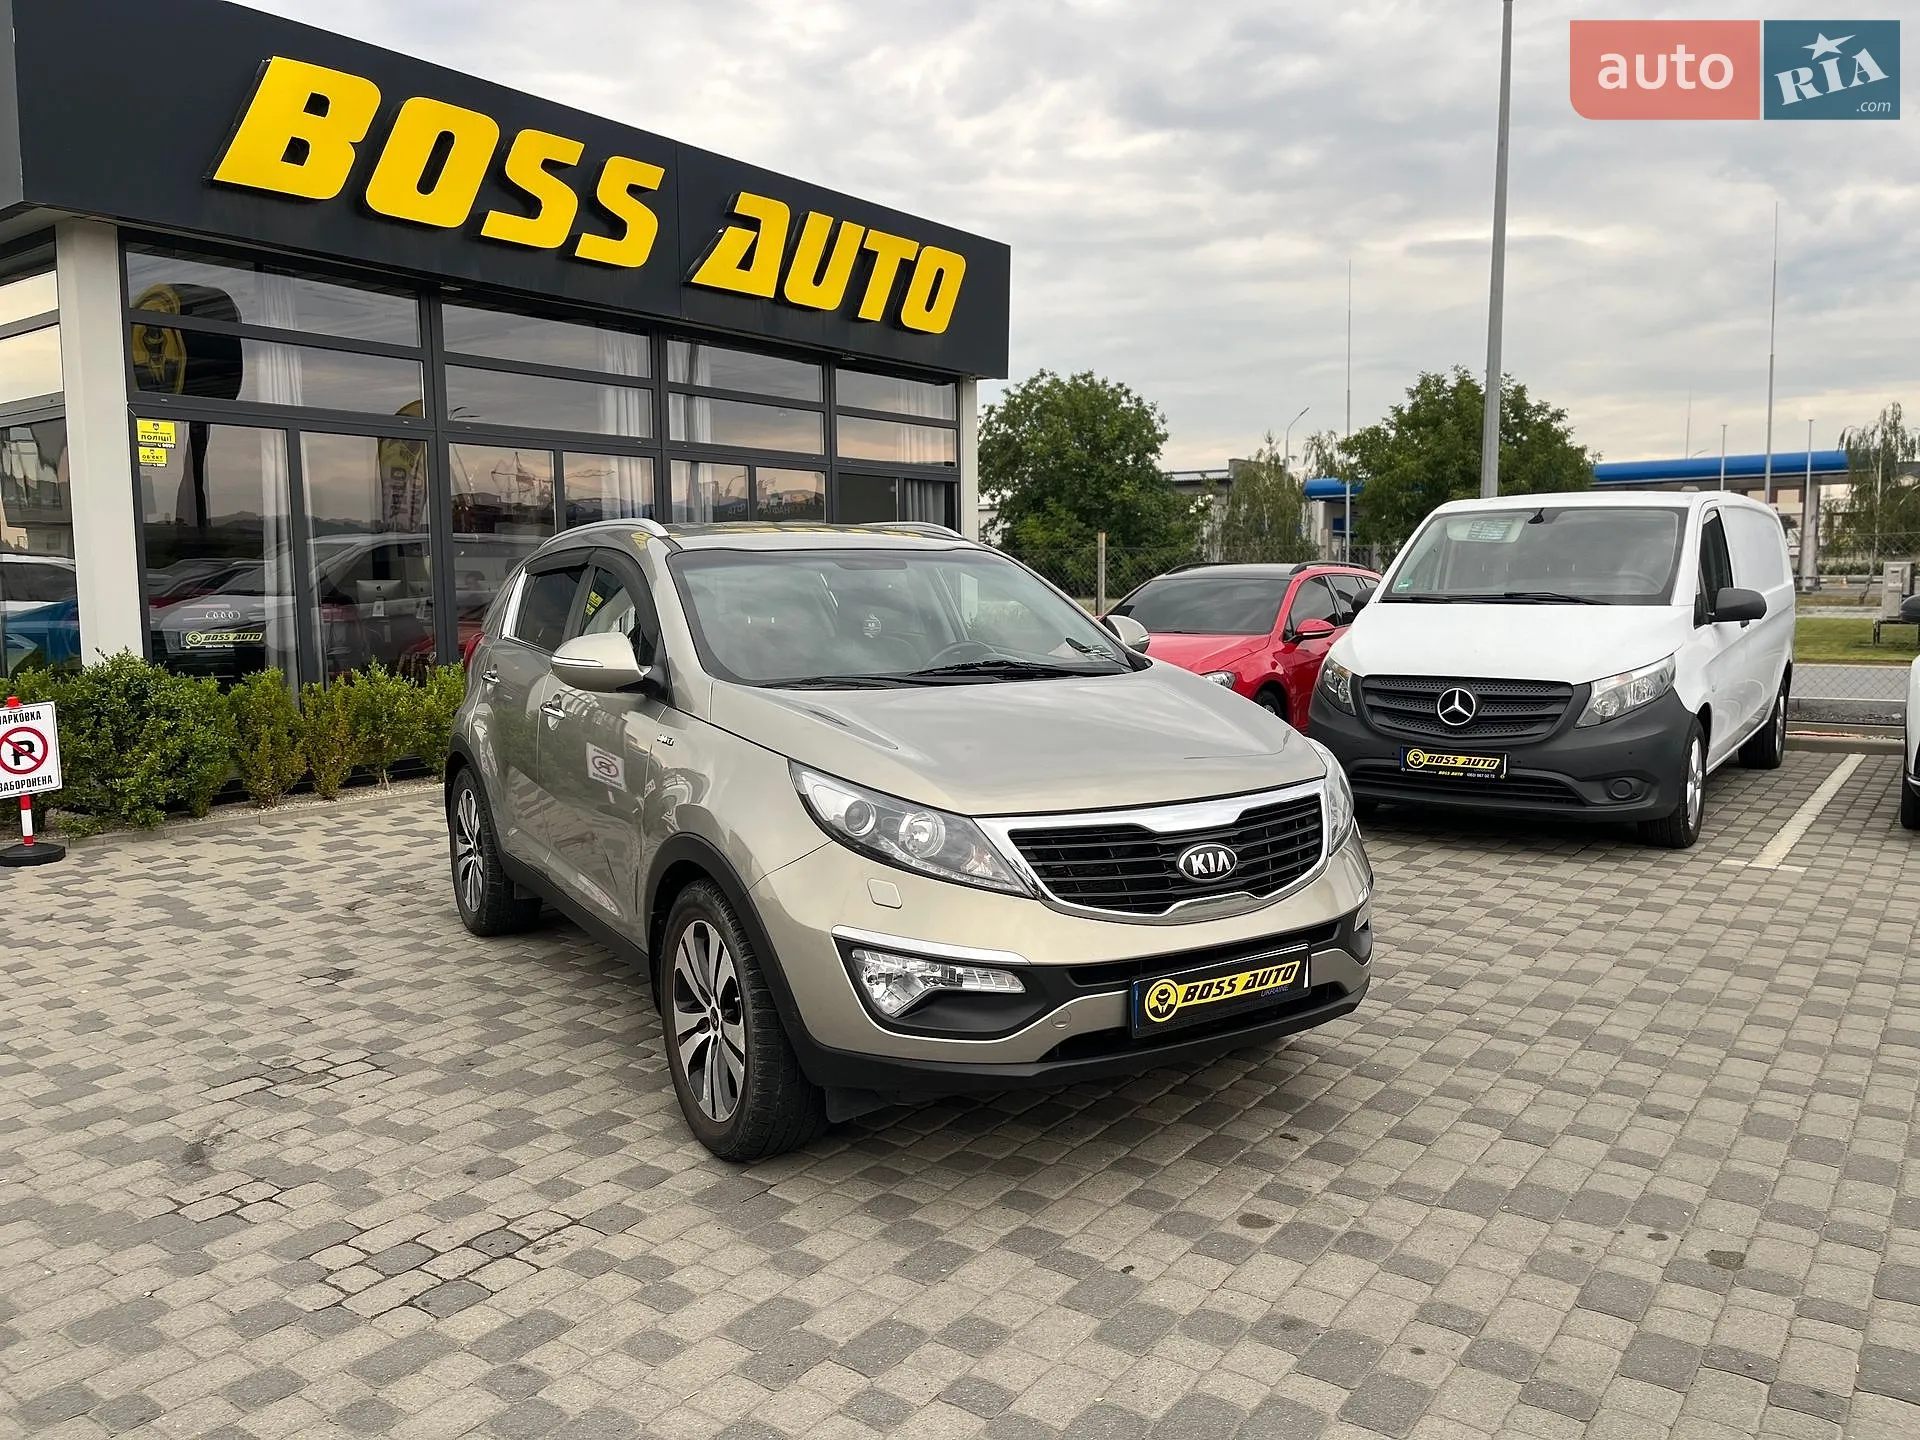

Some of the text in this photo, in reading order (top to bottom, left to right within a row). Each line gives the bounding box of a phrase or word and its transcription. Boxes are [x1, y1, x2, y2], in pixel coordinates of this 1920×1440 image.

[209, 56, 967, 334] BOSS AUTO
[203, 633, 262, 641] BOSS AUTO
[1427, 755, 1498, 768] BOSS AUTO
[1189, 850, 1231, 875] KIA
[1181, 964, 1297, 1004] BOSS AUTO
